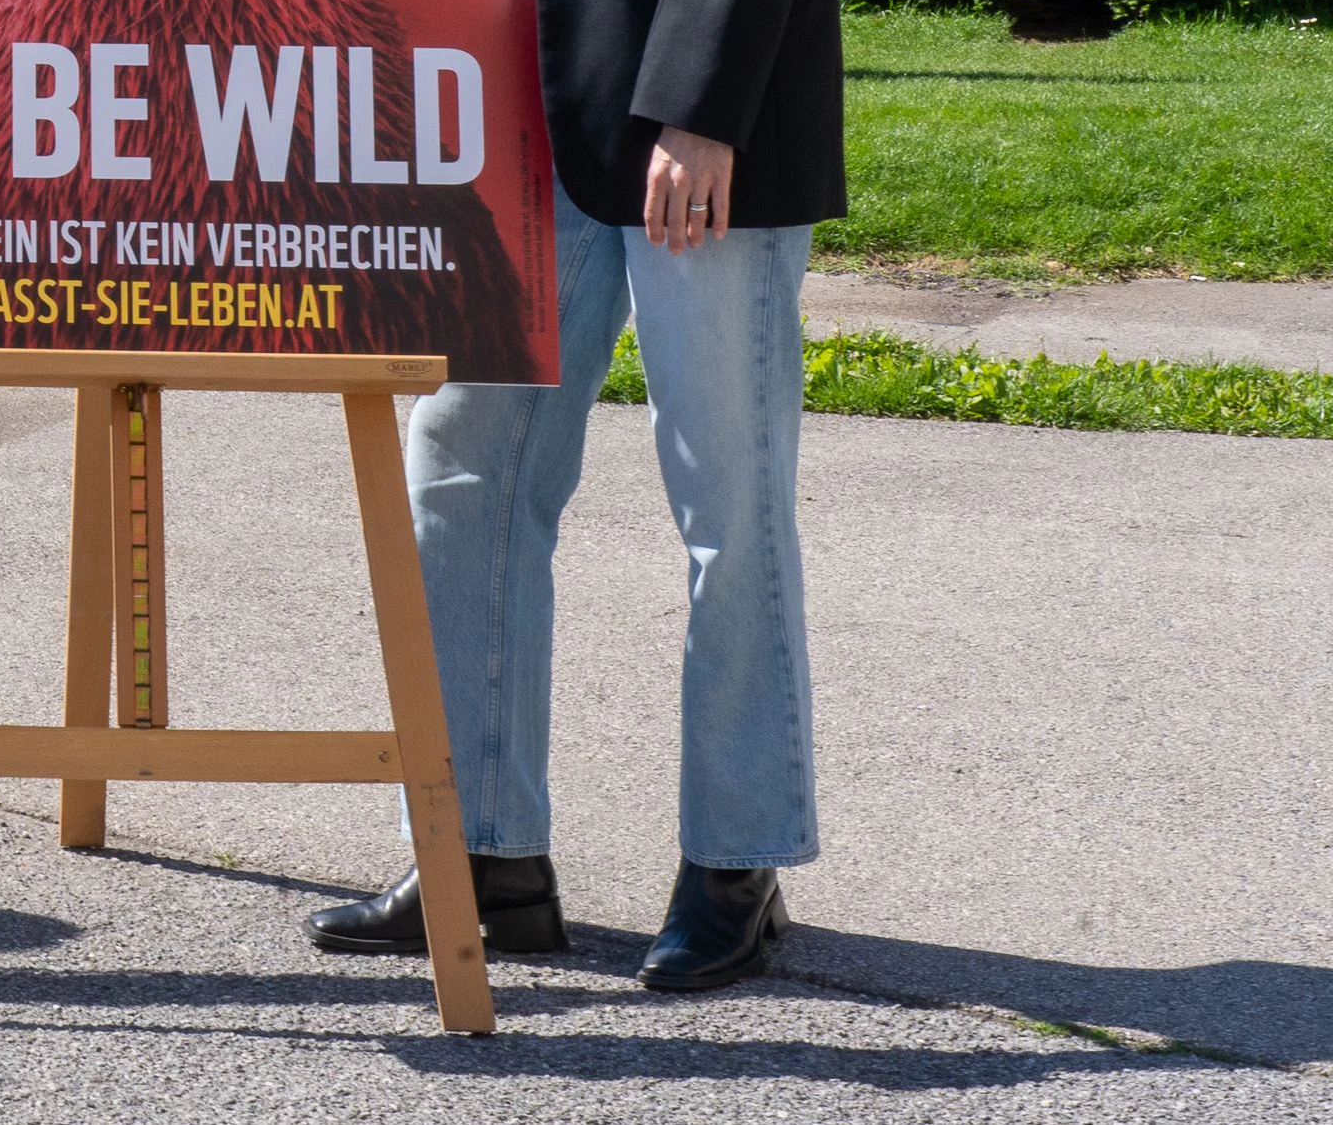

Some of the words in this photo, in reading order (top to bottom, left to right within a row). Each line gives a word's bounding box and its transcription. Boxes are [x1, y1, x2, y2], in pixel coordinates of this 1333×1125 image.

[12, 42, 151, 180] BE
[185, 45, 485, 185] WILD
[50, 220, 106, 265] IST
[117, 221, 194, 266] KEIN
[207, 223, 455, 272] VERBRECHEN.
